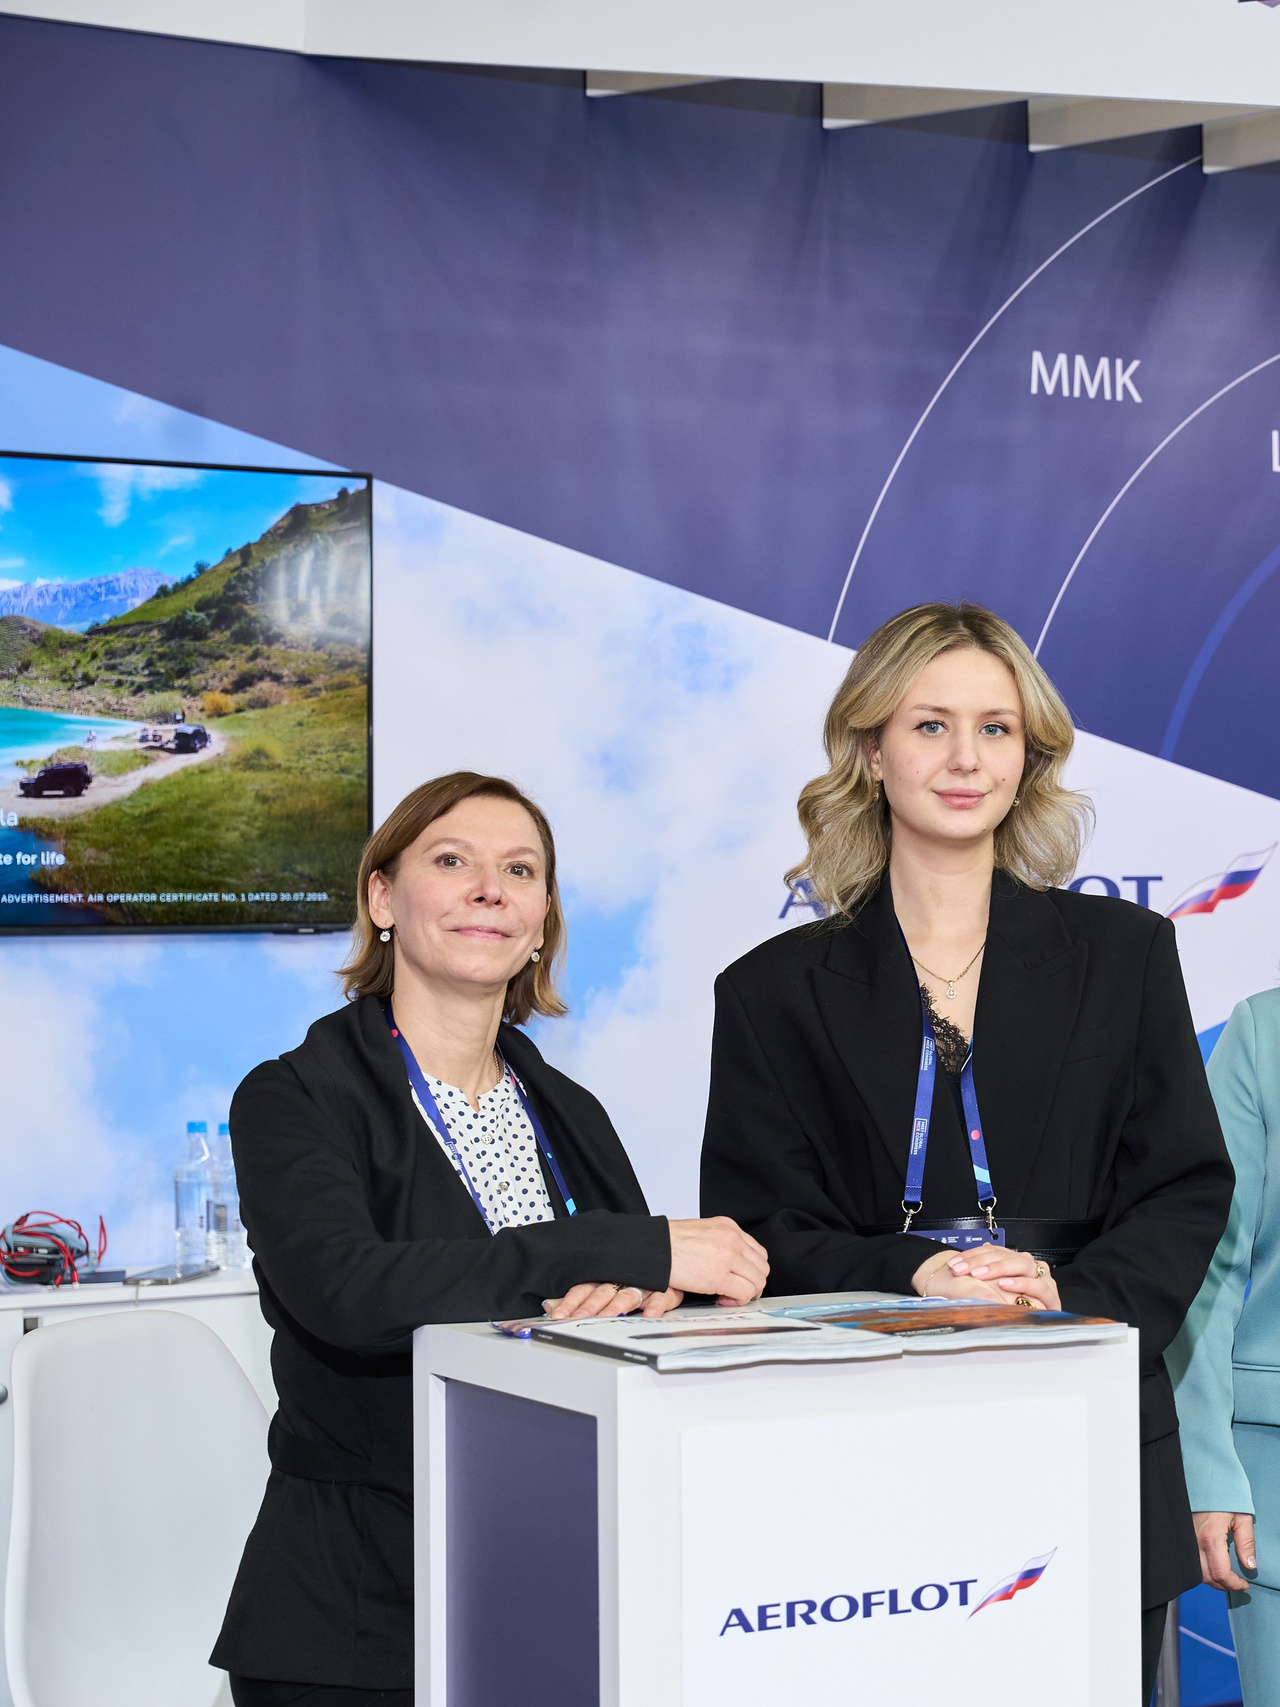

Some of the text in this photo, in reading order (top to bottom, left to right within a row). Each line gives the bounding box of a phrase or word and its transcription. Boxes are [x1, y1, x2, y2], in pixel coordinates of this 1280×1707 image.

[1030, 350, 1143, 403] MMK
[16, 851, 38, 866] for
[41, 850, 66, 866] life
[87, 893, 104, 903] AIR
[106, 892, 158, 903] OPERATOR
[159, 892, 219, 903] CERTIFICATE
[247, 892, 278, 903] DATED
[719, 1579, 978, 1637] AEROFLOT
